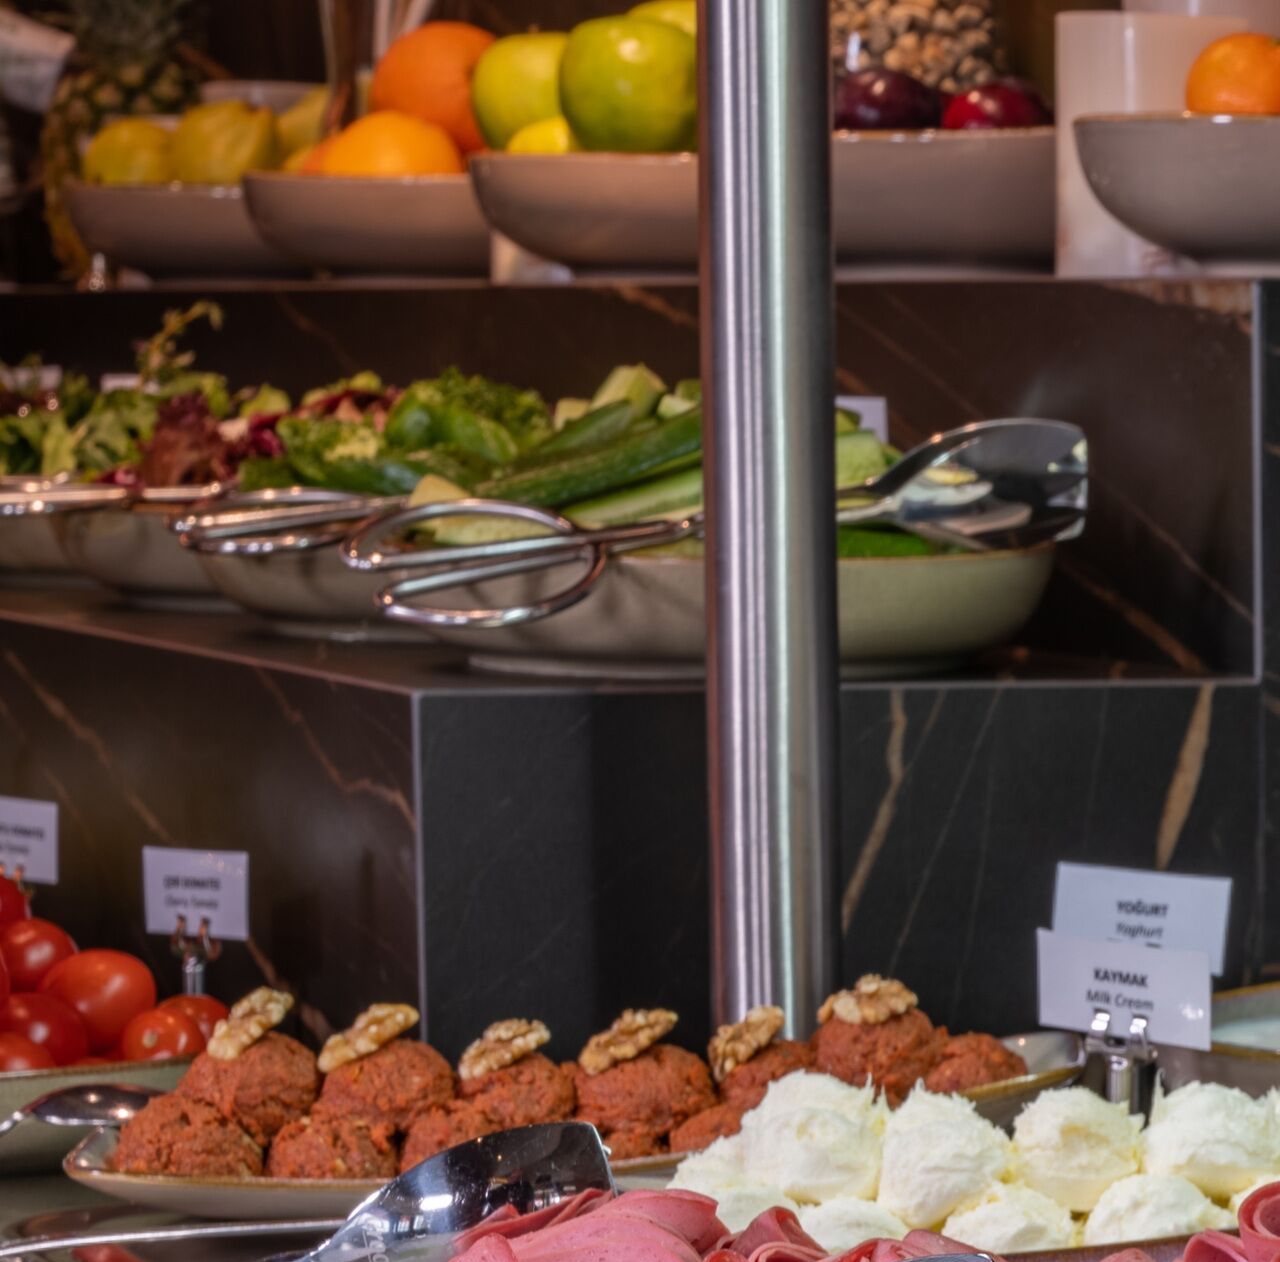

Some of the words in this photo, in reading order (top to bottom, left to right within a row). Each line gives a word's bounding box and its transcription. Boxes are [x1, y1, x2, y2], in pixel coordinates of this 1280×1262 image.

[1117, 899, 1168, 917] YOĞURT
[1116, 923, 1163, 938] Yoghurt
[1093, 967, 1148, 987] KAYMAK
[1086, 989, 1111, 1004] Milk
[1114, 993, 1154, 1010] Cream
